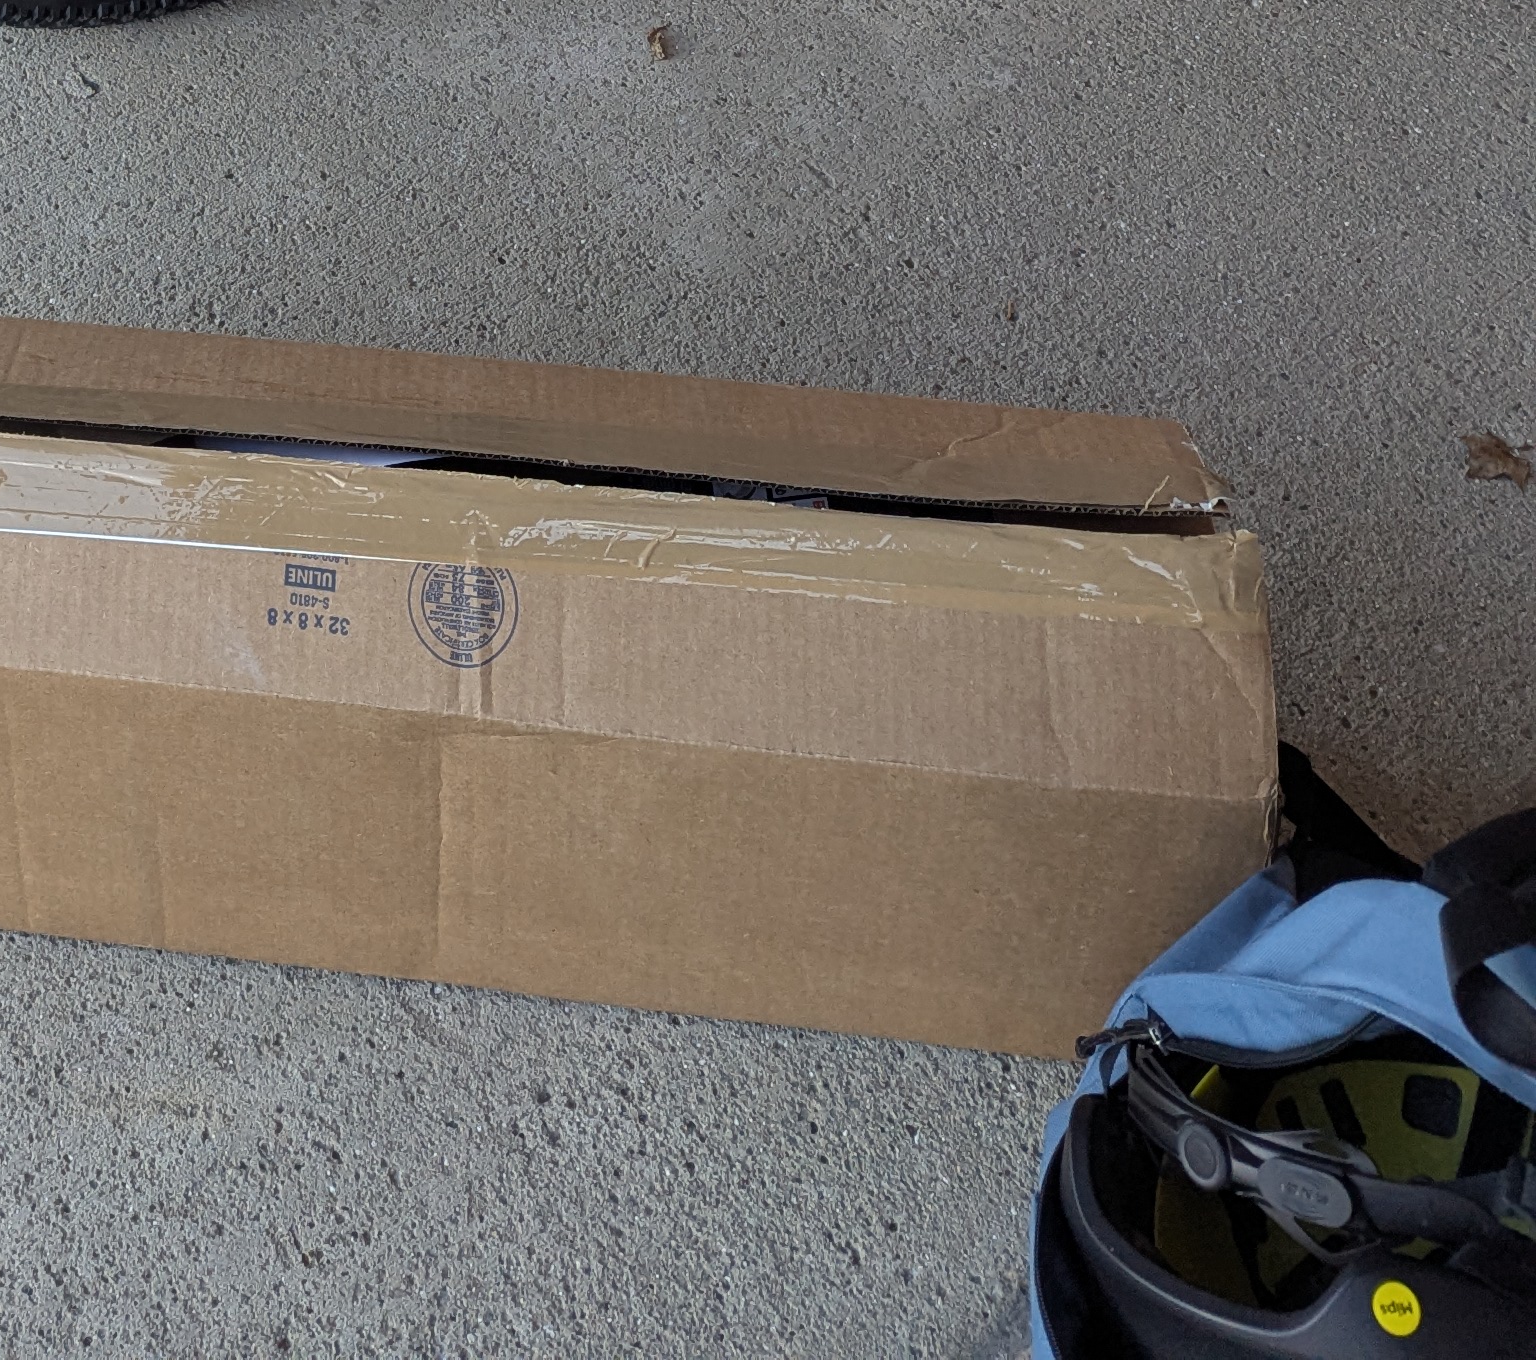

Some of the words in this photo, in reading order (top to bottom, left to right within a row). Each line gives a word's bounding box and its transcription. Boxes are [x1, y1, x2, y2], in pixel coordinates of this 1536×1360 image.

[287, 567, 333, 588] ULINE
[289, 592, 330, 610] S-4810
[267, 607, 278, 626] 8
[298, 612, 309, 630] 8
[328, 615, 351, 636] 32
[1379, 1300, 1414, 1317] Mips
